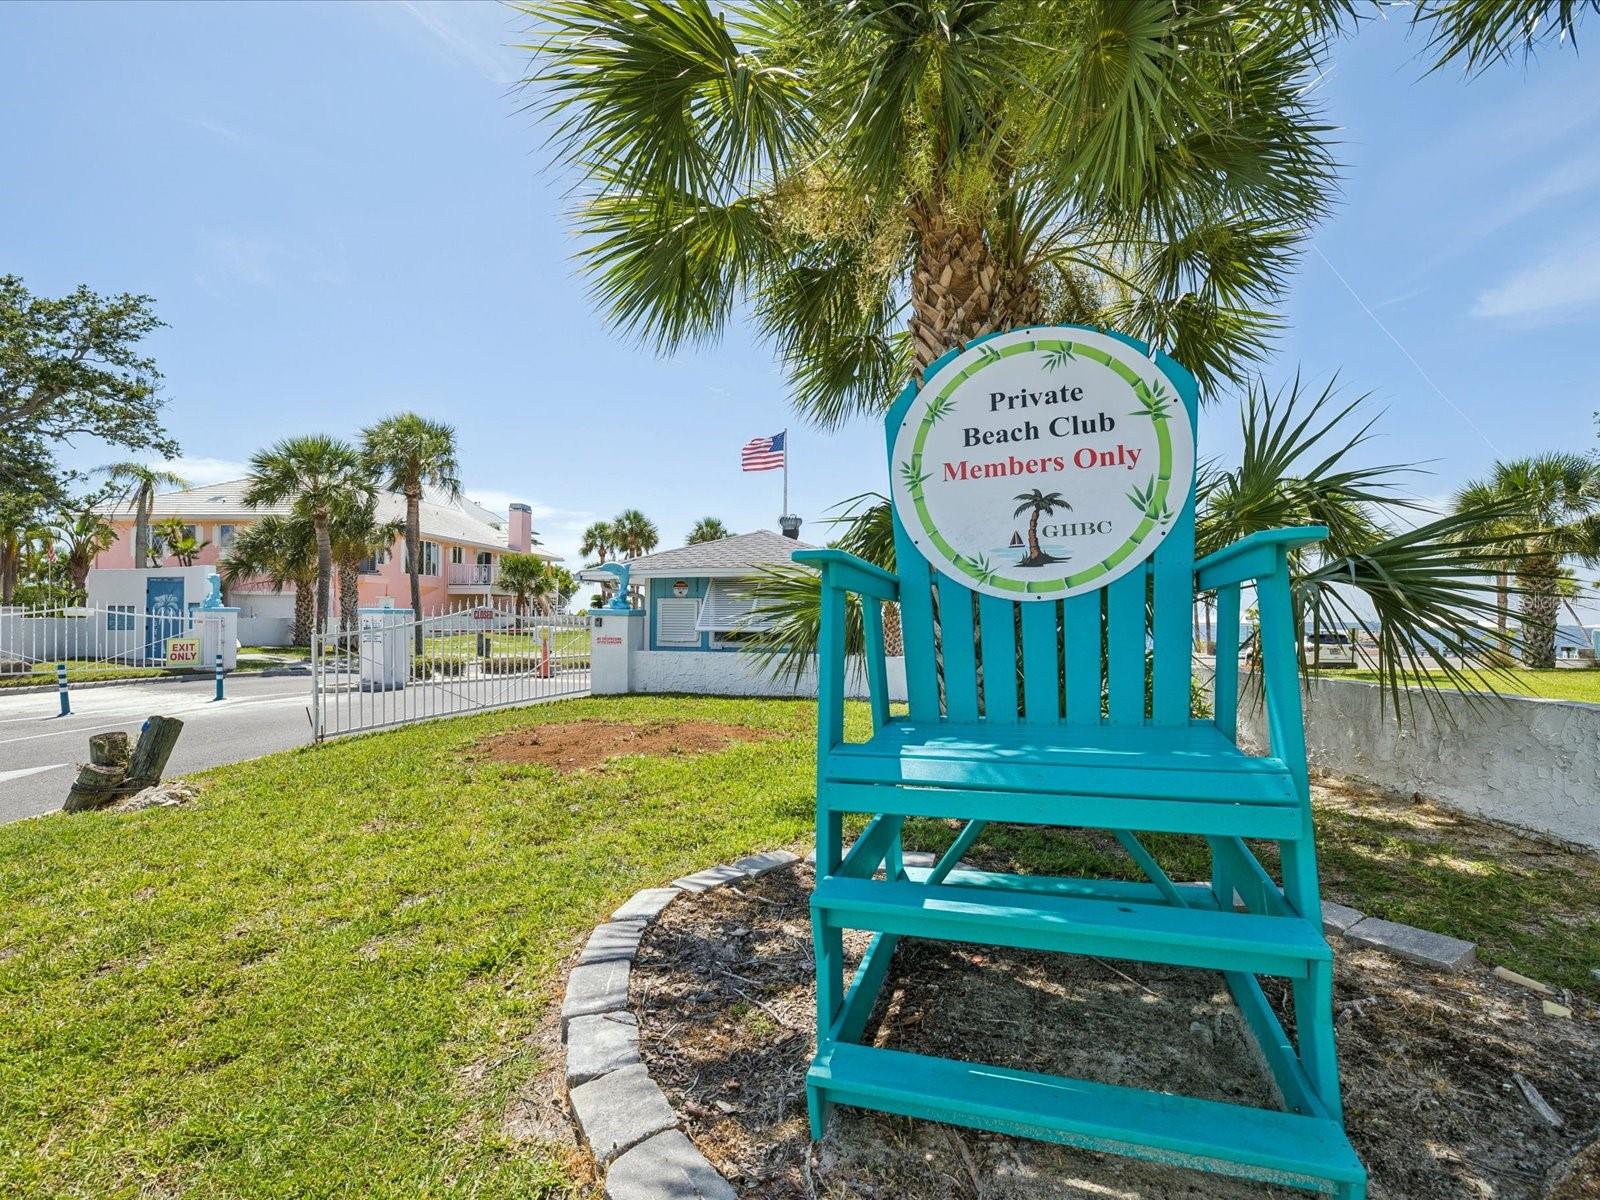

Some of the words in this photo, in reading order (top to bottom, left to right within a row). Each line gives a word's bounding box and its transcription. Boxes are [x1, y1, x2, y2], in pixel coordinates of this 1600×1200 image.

[989, 384, 1084, 412] Private
[962, 421, 1039, 448] Beach
[1049, 413, 1116, 438] Club
[943, 456, 1065, 482] Members
[1074, 444, 1143, 471] Only
[1042, 520, 1113, 539] GHBC
[170, 652, 197, 661] ONLY
[172, 643, 196, 652] EXIT
